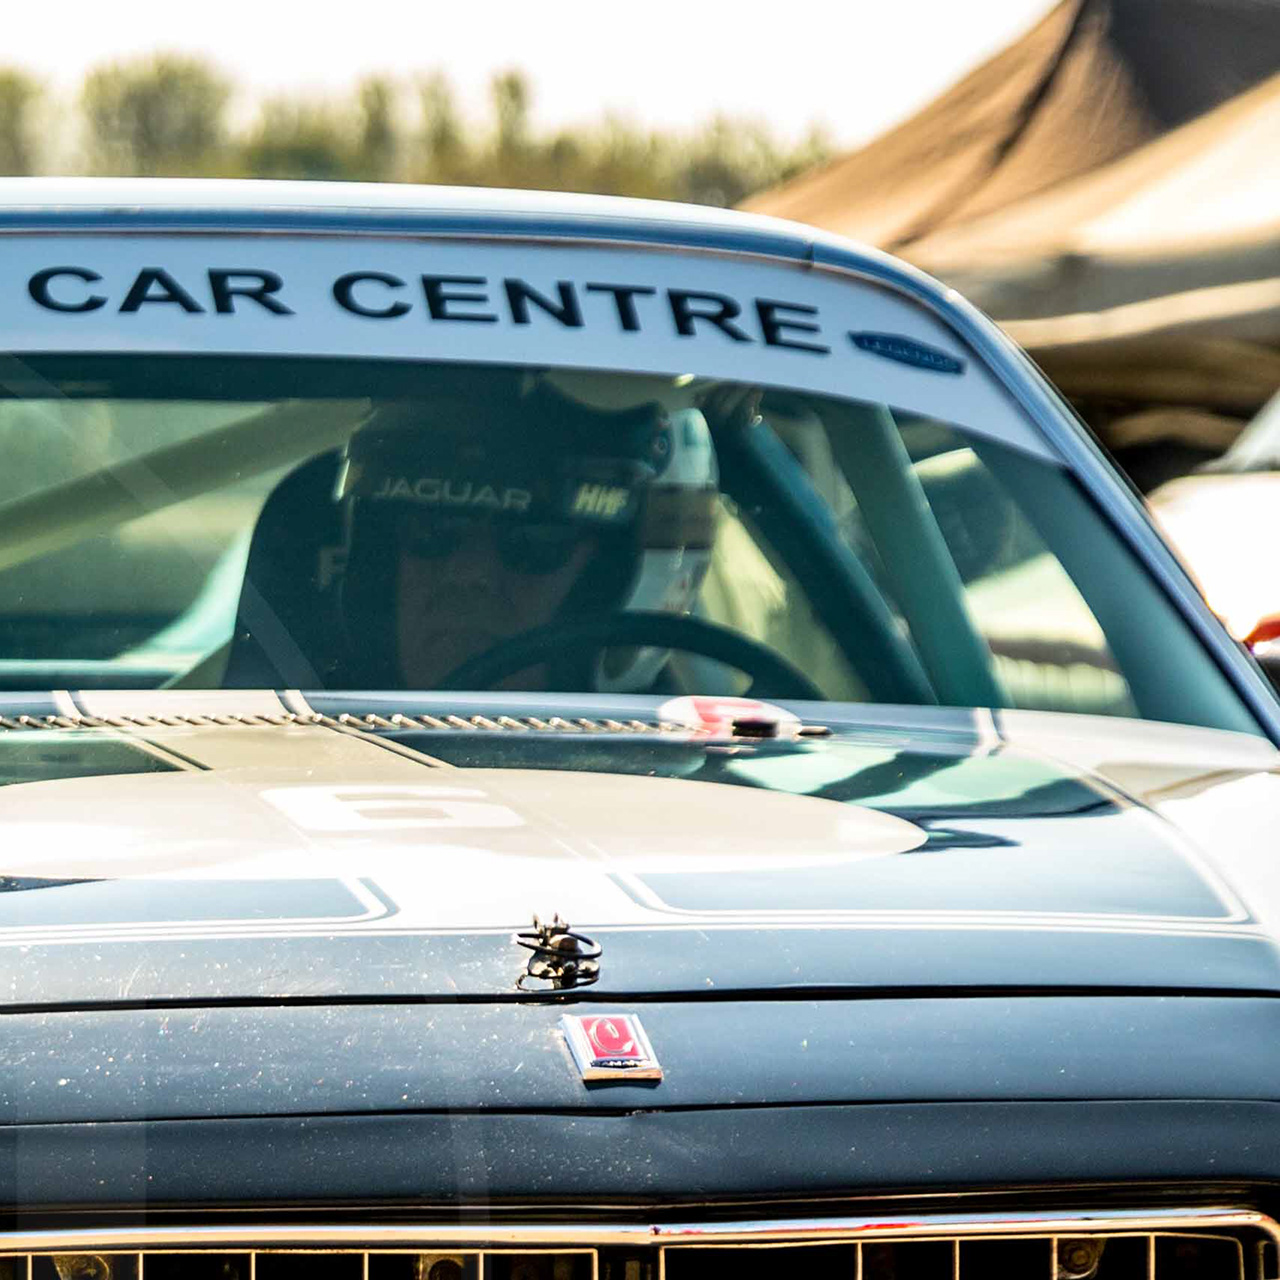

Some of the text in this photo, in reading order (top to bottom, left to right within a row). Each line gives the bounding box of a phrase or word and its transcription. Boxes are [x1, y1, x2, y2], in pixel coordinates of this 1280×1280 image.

[27, 267, 292, 316] CAR
[332, 272, 831, 355] CENTRE
[372, 476, 533, 513] JAGUAR
